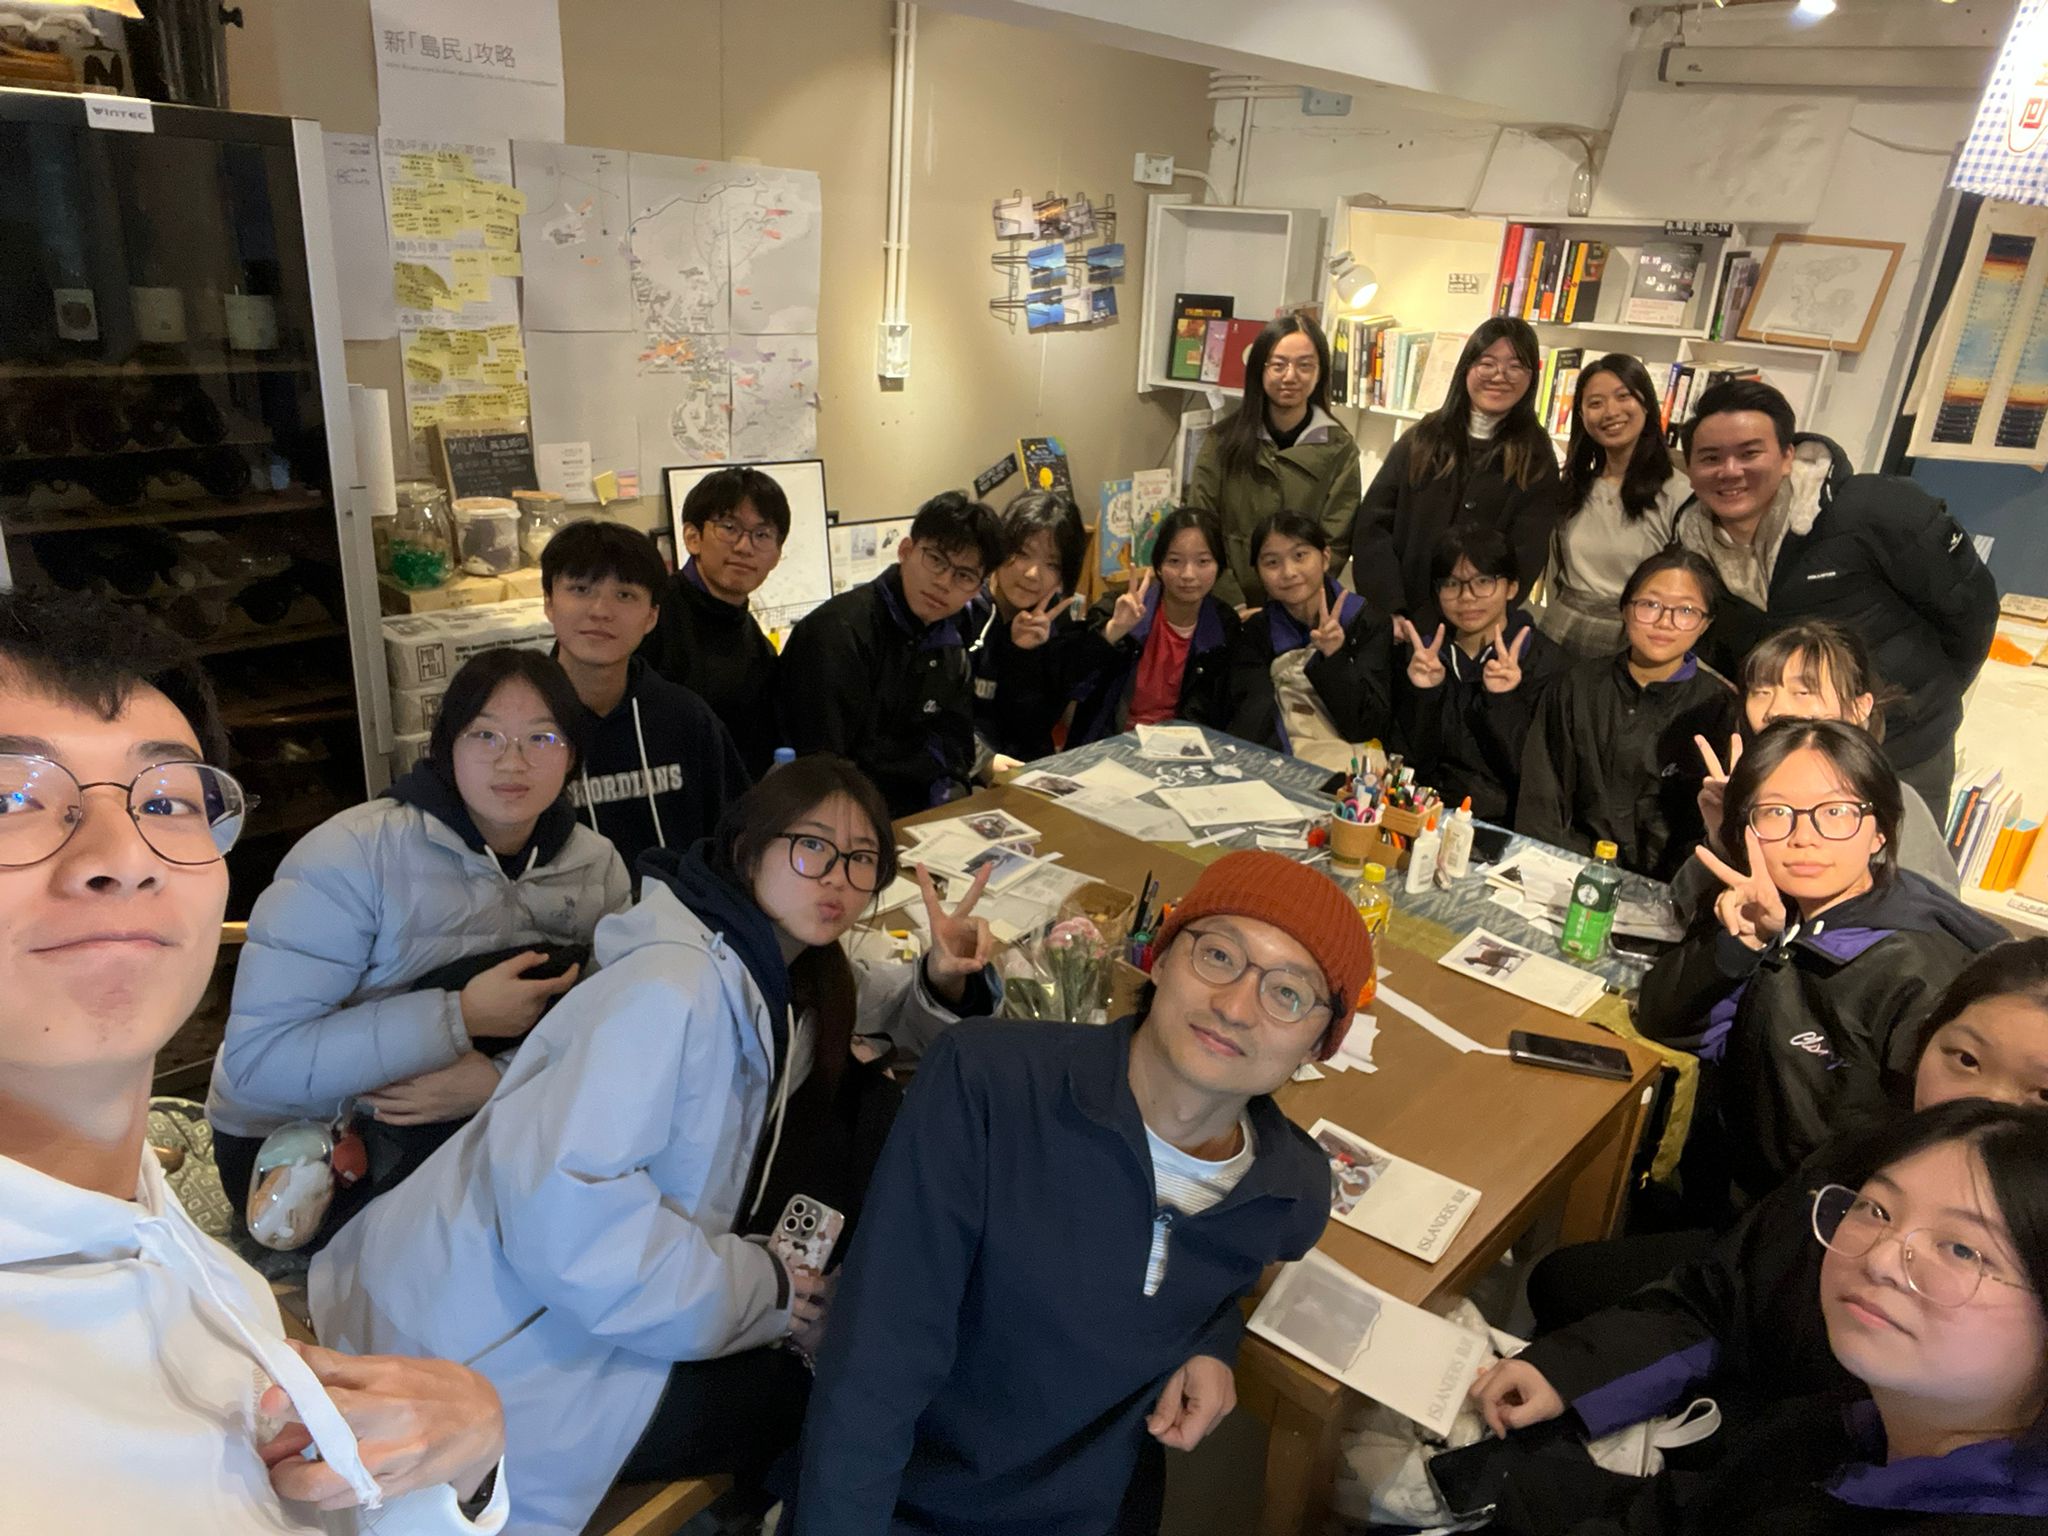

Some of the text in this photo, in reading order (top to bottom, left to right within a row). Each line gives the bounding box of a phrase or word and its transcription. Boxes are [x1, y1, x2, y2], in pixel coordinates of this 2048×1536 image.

[384, 30, 516, 68] 新「島民」攻略
[1417, 1202, 1459, 1252] ISLANDERS
[1427, 1360, 1465, 1422] ISLANDERS
